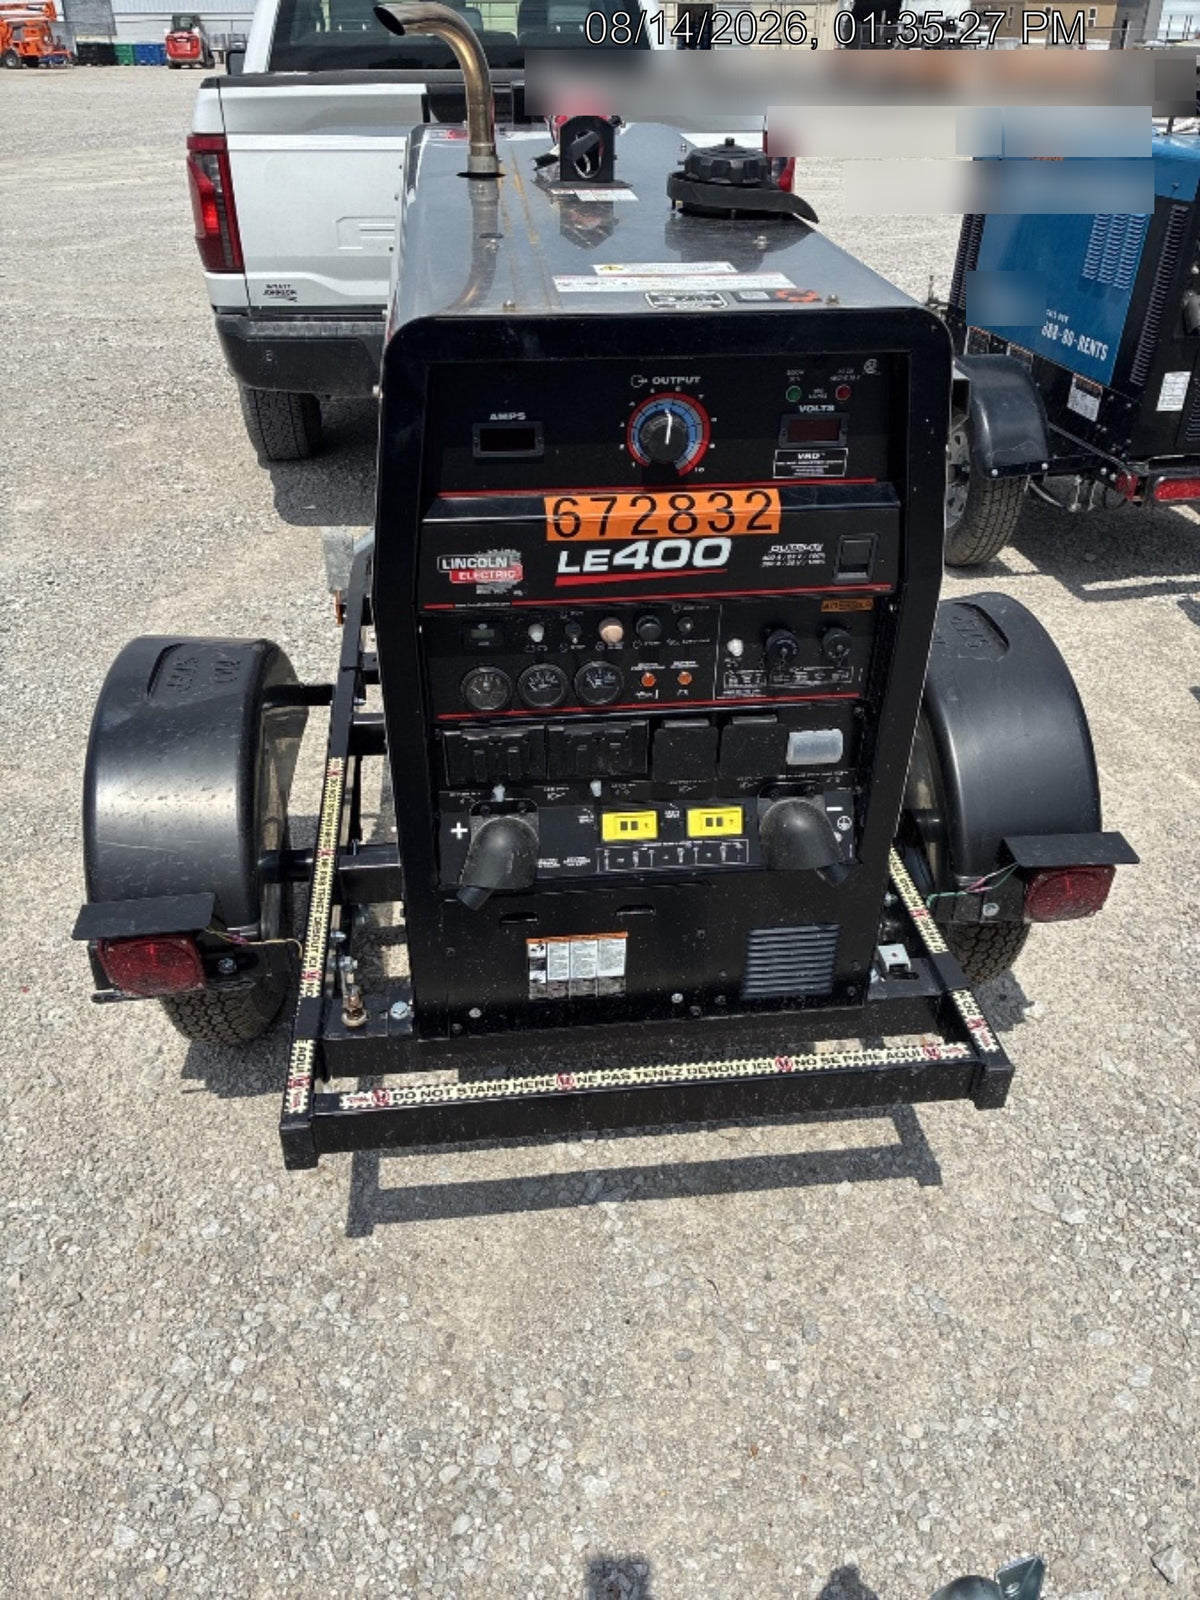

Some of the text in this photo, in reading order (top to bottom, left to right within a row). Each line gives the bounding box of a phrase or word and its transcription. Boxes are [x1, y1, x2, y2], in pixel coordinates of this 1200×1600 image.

[652, 376, 701, 385] OUTPUT
[799, 405, 836, 413] VOLTS
[488, 412, 527, 420] AMPS
[552, 490, 773, 538] 672832
[557, 537, 732, 573] LE400
[442, 556, 508, 570] LINCOLN
[458, 570, 516, 580] ELECTRIC
[393, 1090, 416, 1101] DO
[420, 1087, 452, 1100] NOT
[456, 1083, 510, 1096] STAND
[512, 1079, 552, 1091] HERE
[576, 1075, 596, 1086] NE
[600, 1072, 633, 1082] PAS
[636, 1068, 682, 1080] TENEZ
[687, 1064, 750, 1076] DEBOUT
[795, 1058, 818, 1068] NO
[822, 1055, 841, 1066] SE
[842, 1052, 882, 1064] PARE
[886, 1049, 921, 1061] AQUI
